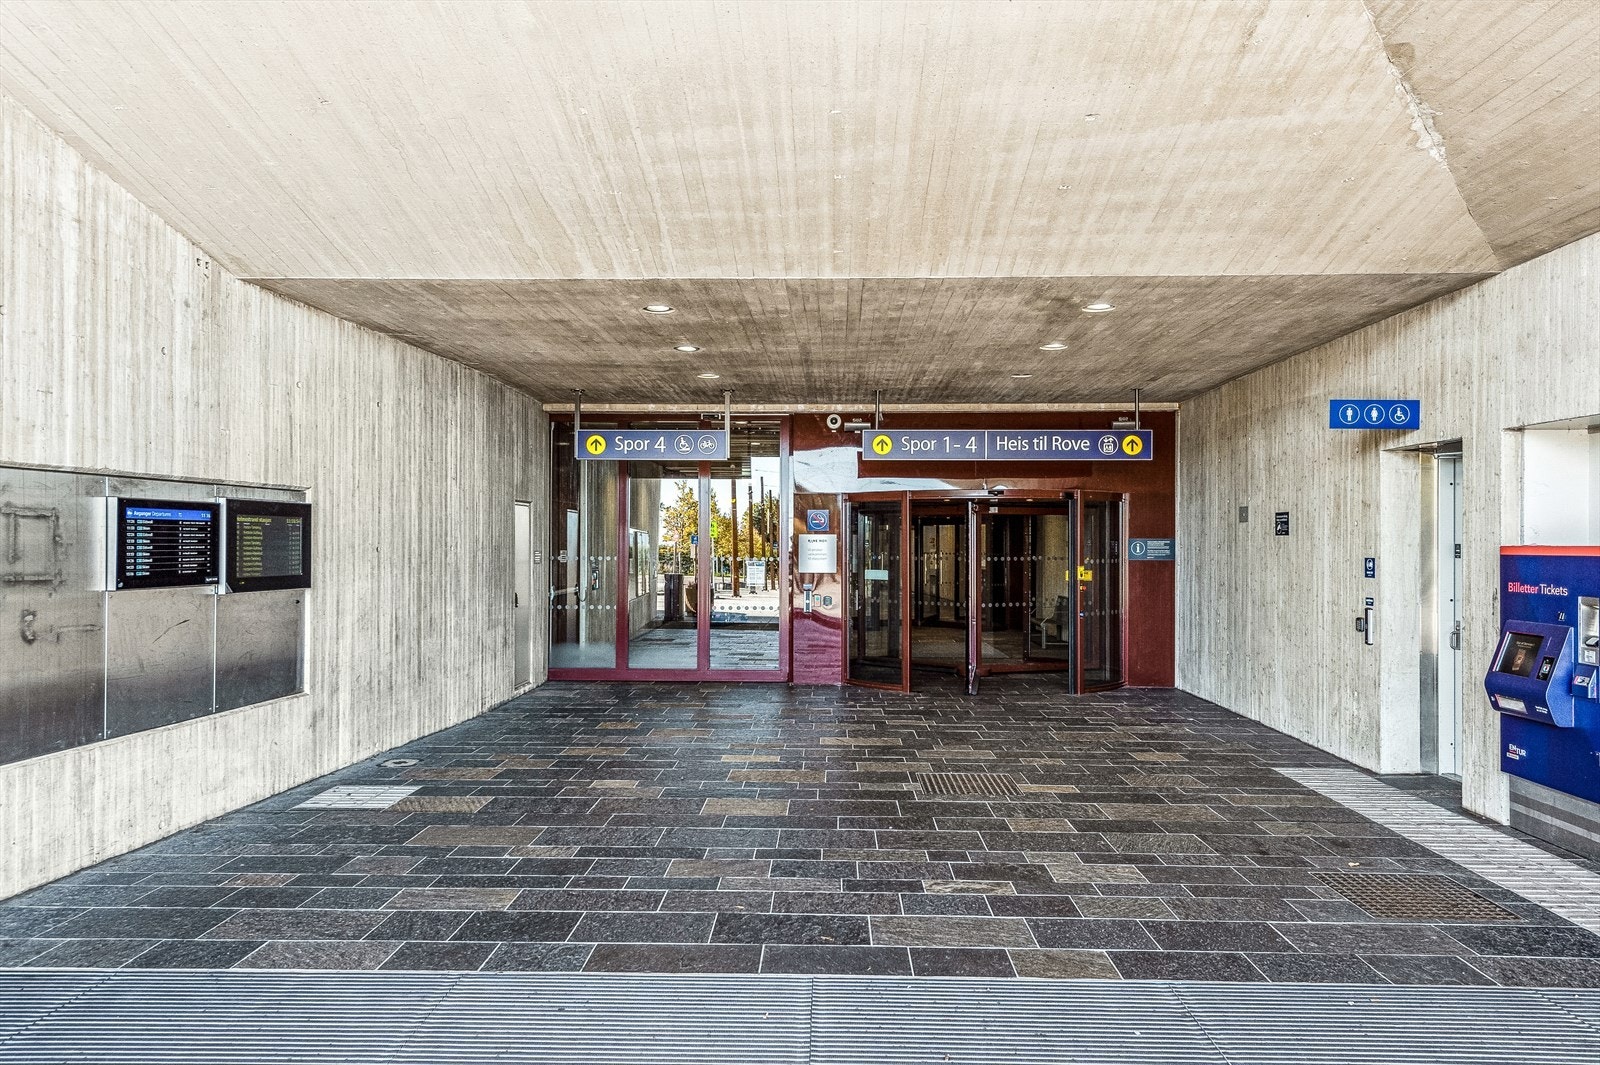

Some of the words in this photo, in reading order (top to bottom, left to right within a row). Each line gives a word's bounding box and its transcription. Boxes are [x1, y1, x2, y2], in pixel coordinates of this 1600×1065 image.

[614, 435, 651, 455] Spor
[653, 436, 667, 453] 4
[901, 436, 937, 455] Spor
[996, 436, 1029, 451] Heis
[1032, 435, 1048, 451] til
[1052, 435, 1090, 451] Rove
[1507, 582, 1539, 594] Billetter
[1539, 583, 1569, 596] Tickets
